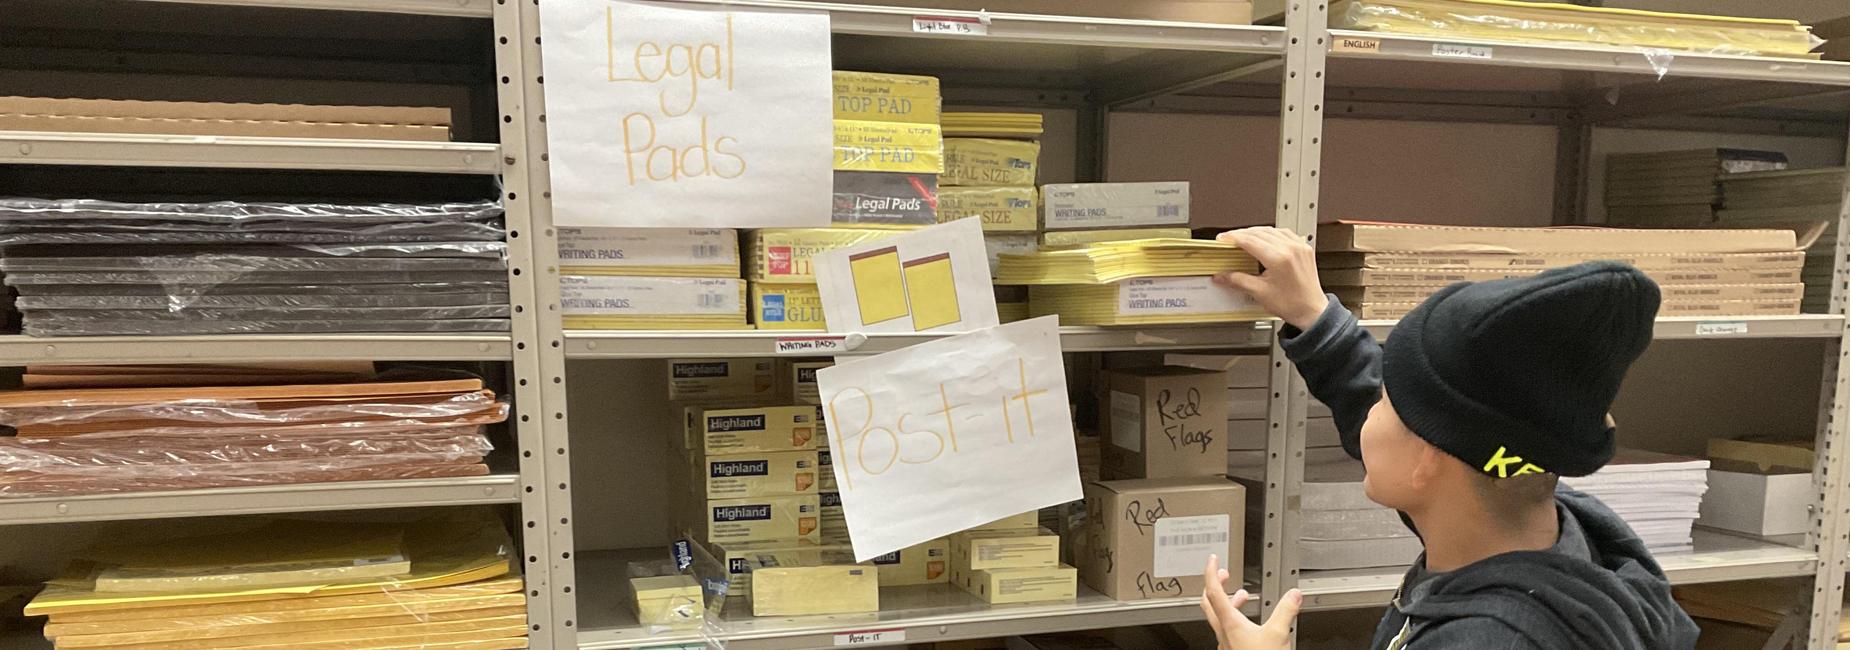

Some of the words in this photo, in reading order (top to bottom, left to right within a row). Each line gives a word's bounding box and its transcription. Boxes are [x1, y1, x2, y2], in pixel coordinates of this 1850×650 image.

[1343, 40, 1376, 49] ENGLISH
[607, 6, 733, 117] Legal
[838, 96, 872, 113] TOP
[878, 97, 912, 115] PAD
[622, 111, 747, 186] Pads
[841, 146, 875, 162] TOP
[880, 147, 915, 163] PAD
[982, 168, 1011, 184] SIZE
[856, 197, 890, 213] Legal
[891, 197, 921, 211] Pads
[982, 210, 1012, 225] SIZE
[1055, 208, 1086, 218] WRITING
[1087, 208, 1107, 217] PADS
[598, 248, 624, 260] PADS
[560, 298, 602, 309] WRITING
[604, 298, 630, 309] PADS
[1128, 299, 1164, 309] WRITING
[1165, 298, 1187, 308] PADS
[815, 340, 837, 349] PADS
[676, 364, 725, 377] Highland
[1157, 387, 1202, 425] Red
[711, 416, 761, 431] Highland
[1164, 424, 1213, 454] Flags
[713, 461, 764, 476] Highland
[716, 506, 767, 520] Highland
[1125, 498, 1169, 535] Red
